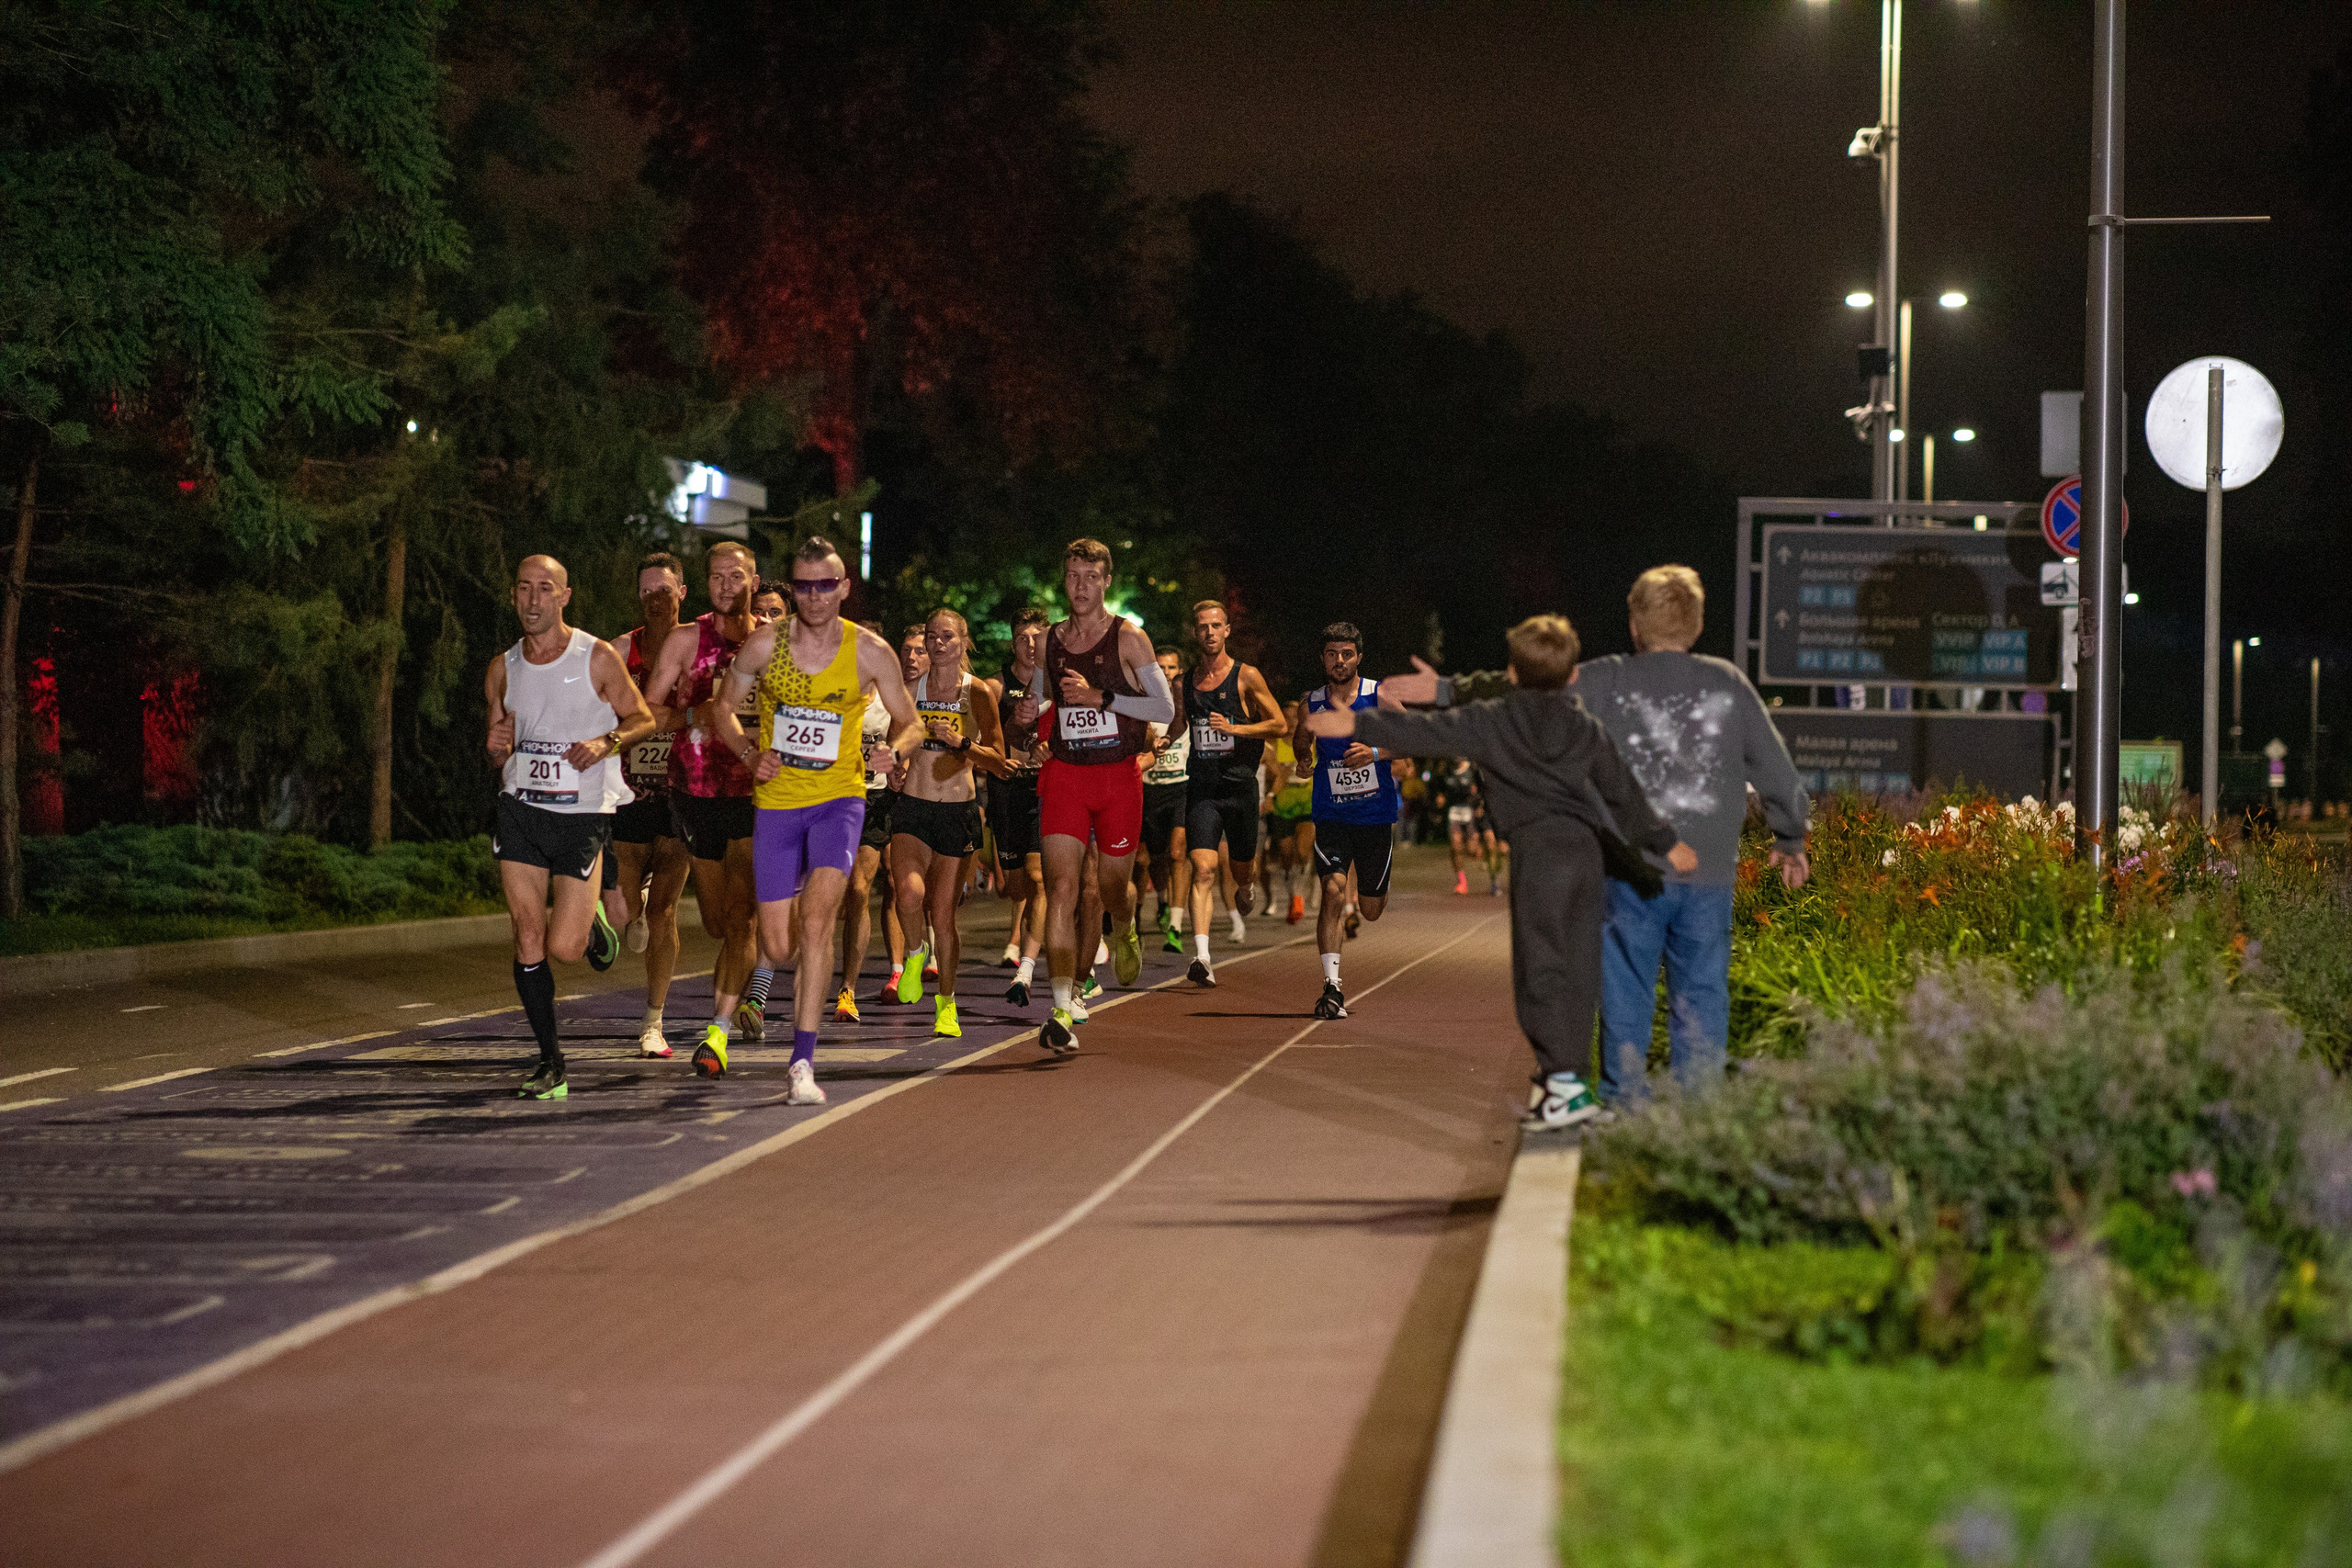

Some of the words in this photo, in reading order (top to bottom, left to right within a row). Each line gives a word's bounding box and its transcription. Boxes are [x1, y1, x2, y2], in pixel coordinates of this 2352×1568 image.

[1067, 710, 1107, 728] 4581
[786, 724, 825, 746] 265
[790, 745, 816, 753] СЕРГЕЙ
[529, 760, 560, 779] 201
[1336, 769, 1370, 785] 4539
